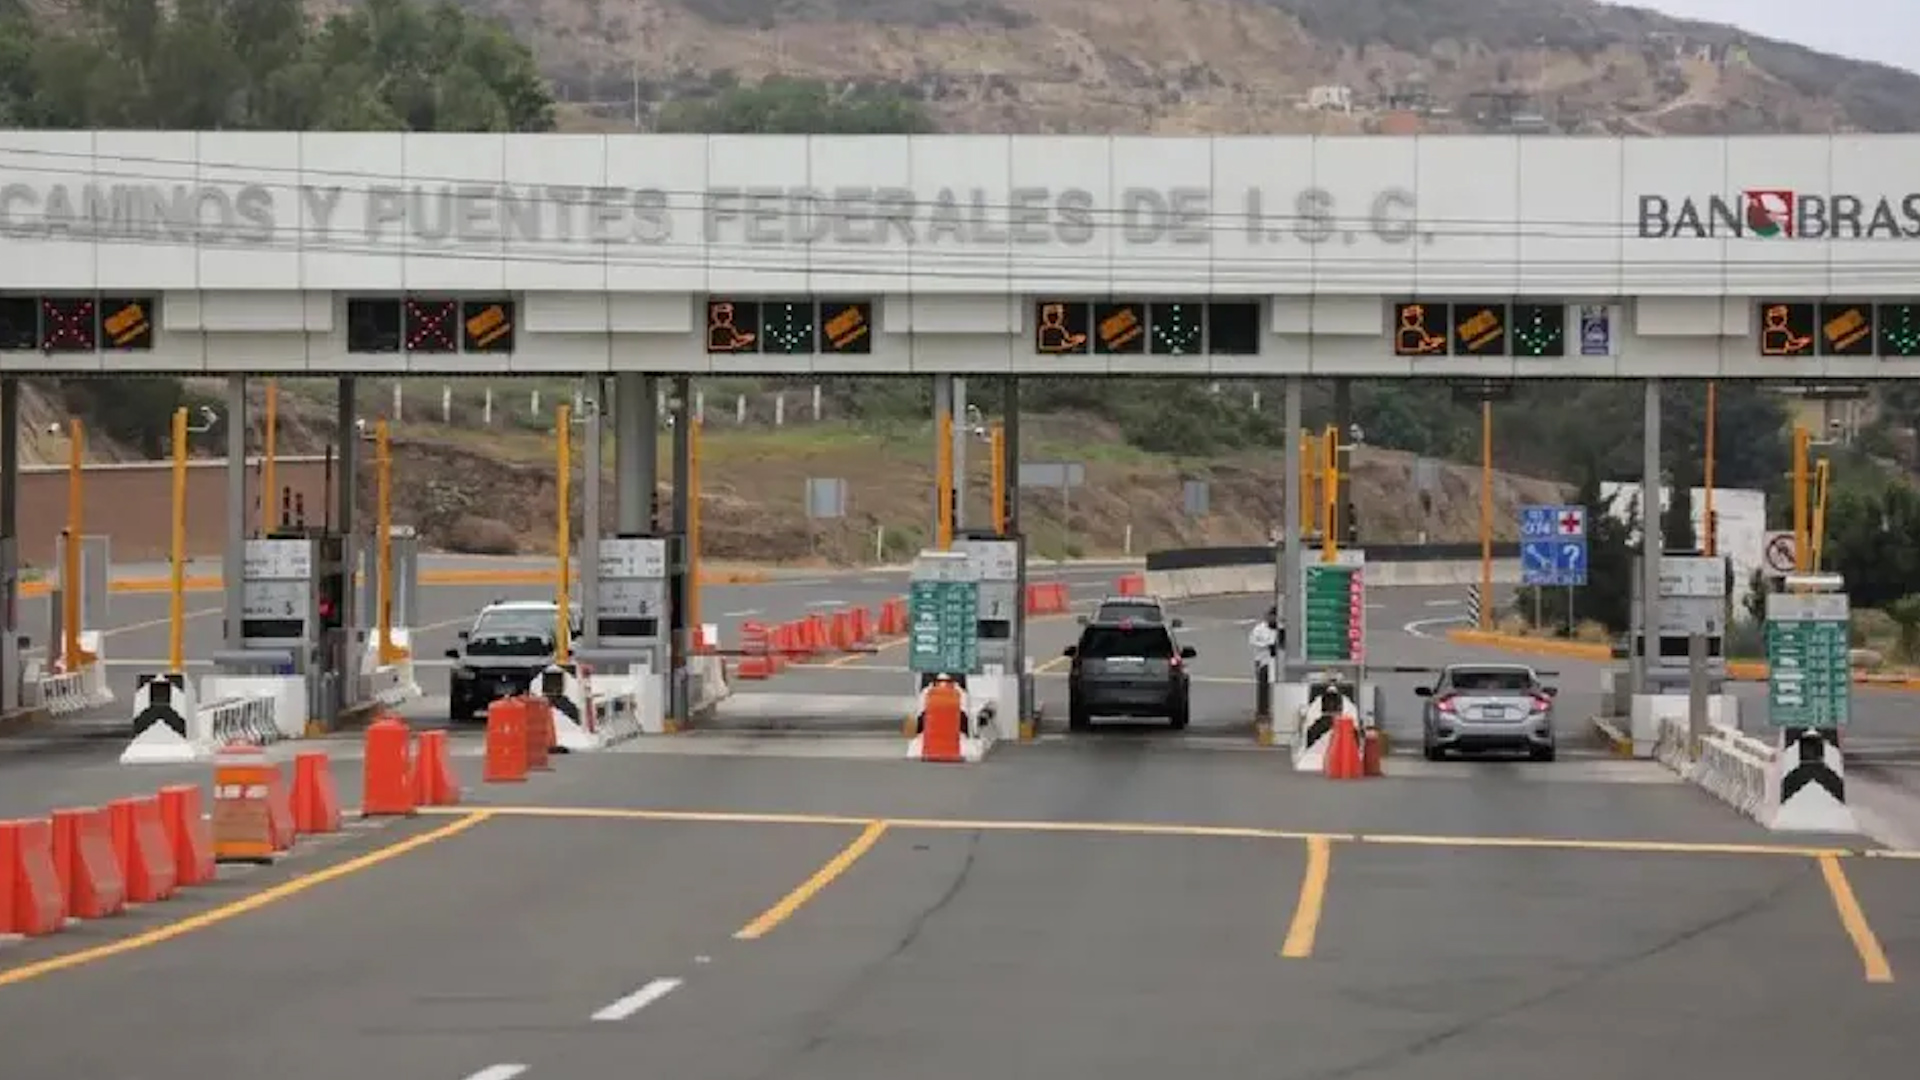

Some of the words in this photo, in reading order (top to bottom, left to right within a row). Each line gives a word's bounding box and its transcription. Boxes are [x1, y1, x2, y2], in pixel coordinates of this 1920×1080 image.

[0, 183, 274, 243] CAMINOS
[302, 184, 342, 242] Y
[365, 184, 672, 243] PUENTES
[702, 187, 1095, 245] FEDERALES
[1123, 187, 1210, 244] DE
